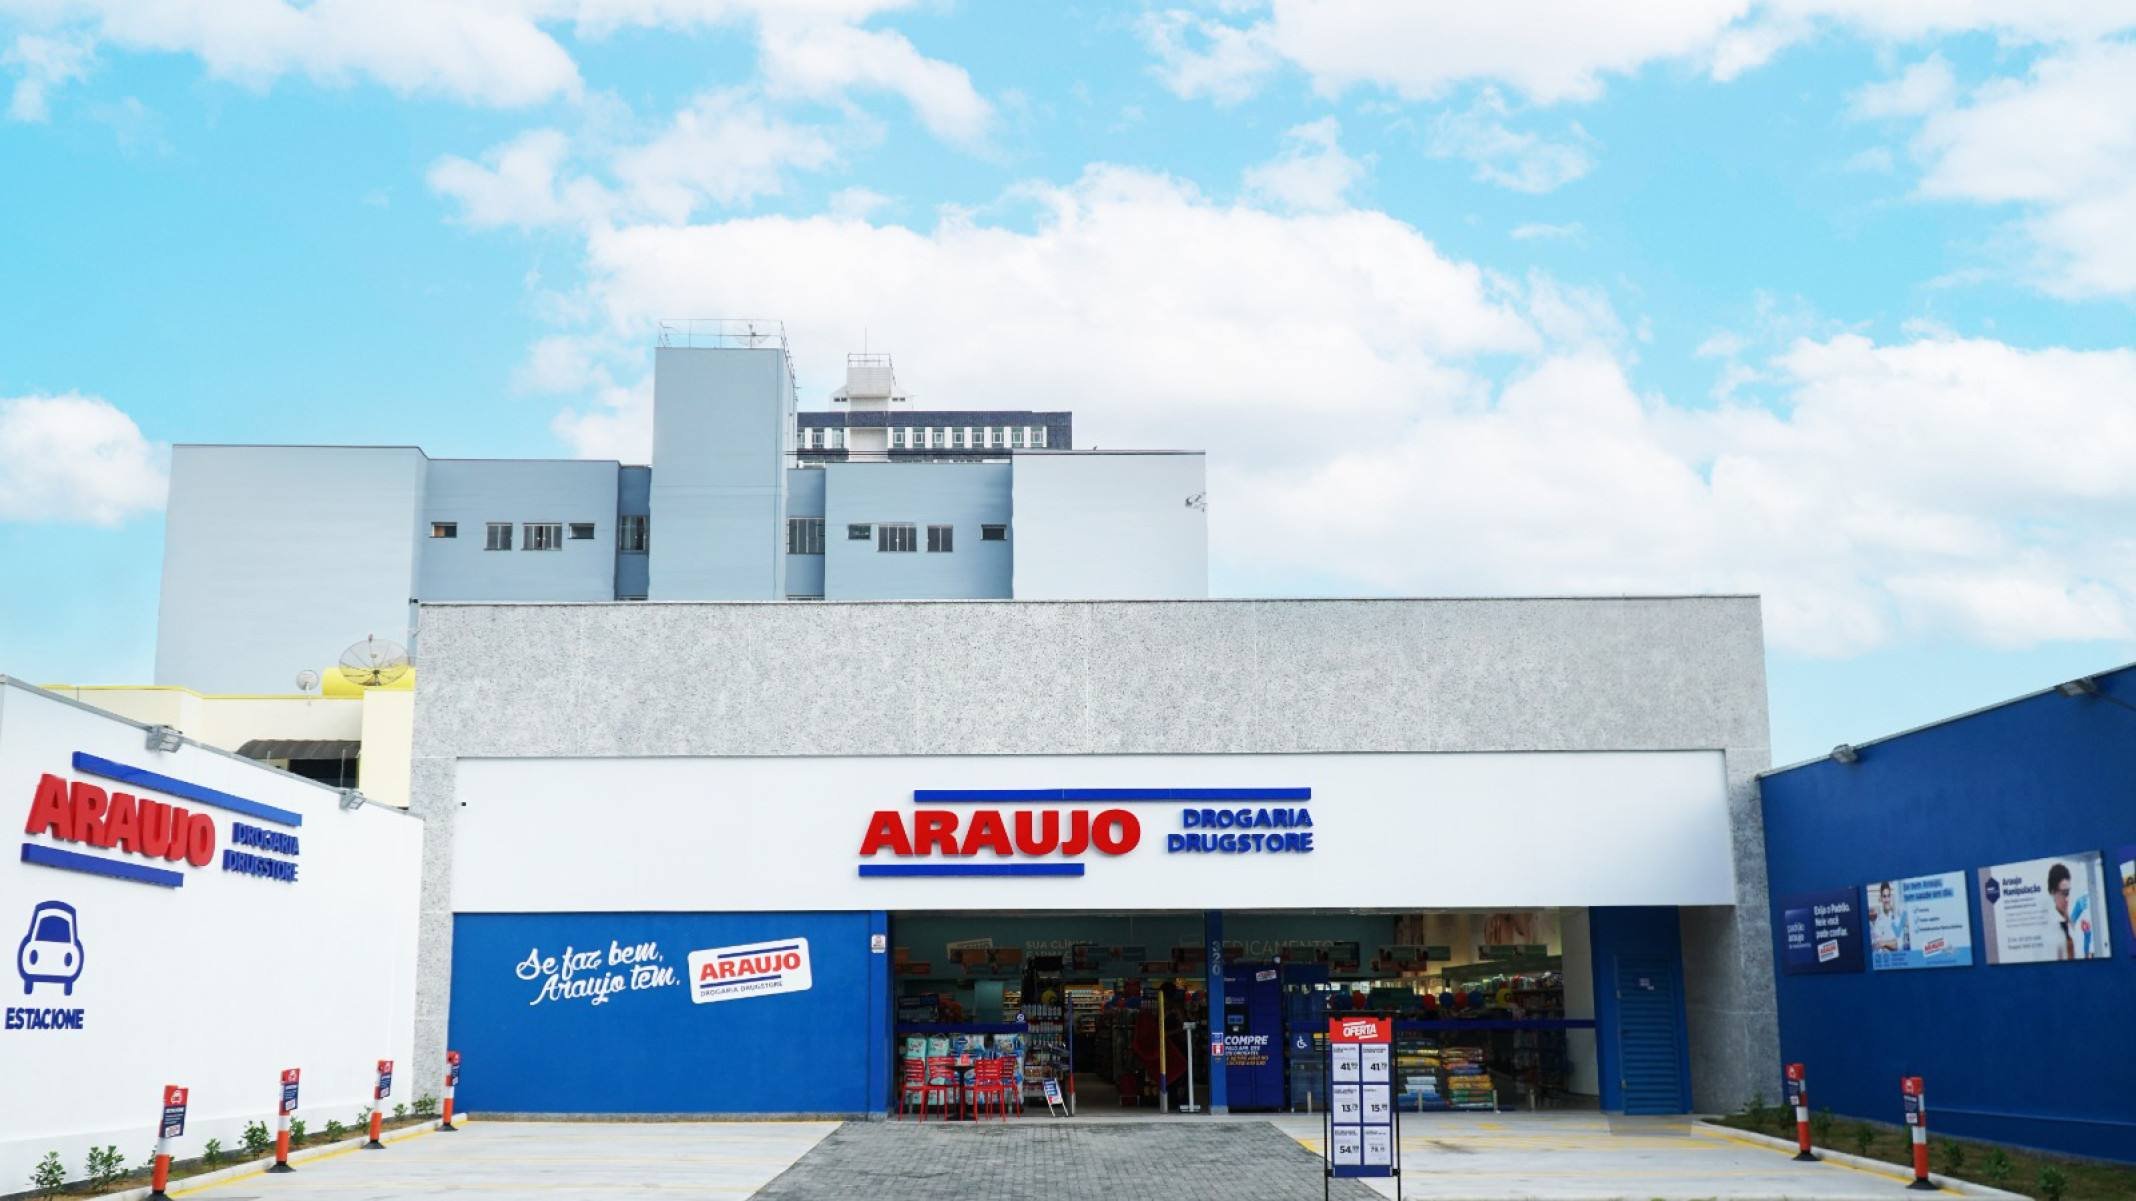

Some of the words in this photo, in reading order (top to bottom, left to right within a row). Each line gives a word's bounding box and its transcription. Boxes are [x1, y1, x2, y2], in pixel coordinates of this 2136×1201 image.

[25, 773, 216, 867] ARAUJO
[859, 808, 1141, 857] ARAUJO
[1182, 807, 1314, 829] DROGARIA
[231, 821, 300, 857] DROGARIA
[1167, 831, 1314, 854] DRUGSTORE
[223, 849, 299, 882] DRUGSTORE
[516, 948, 559, 980] Se
[562, 946, 602, 981] faz
[608, 940, 663, 966] bem,
[700, 952, 801, 981] ARAUJO
[530, 971, 626, 1006] Araujo
[631, 964, 681, 991] tem.
[700, 985, 739, 997] DROGARIA
[740, 980, 783, 993] DRUGSTORE
[5, 1008, 84, 1030] ESTACIONE
[1343, 1024, 1376, 1037] OFERTA
[1225, 1034, 1269, 1045] COMPRE
